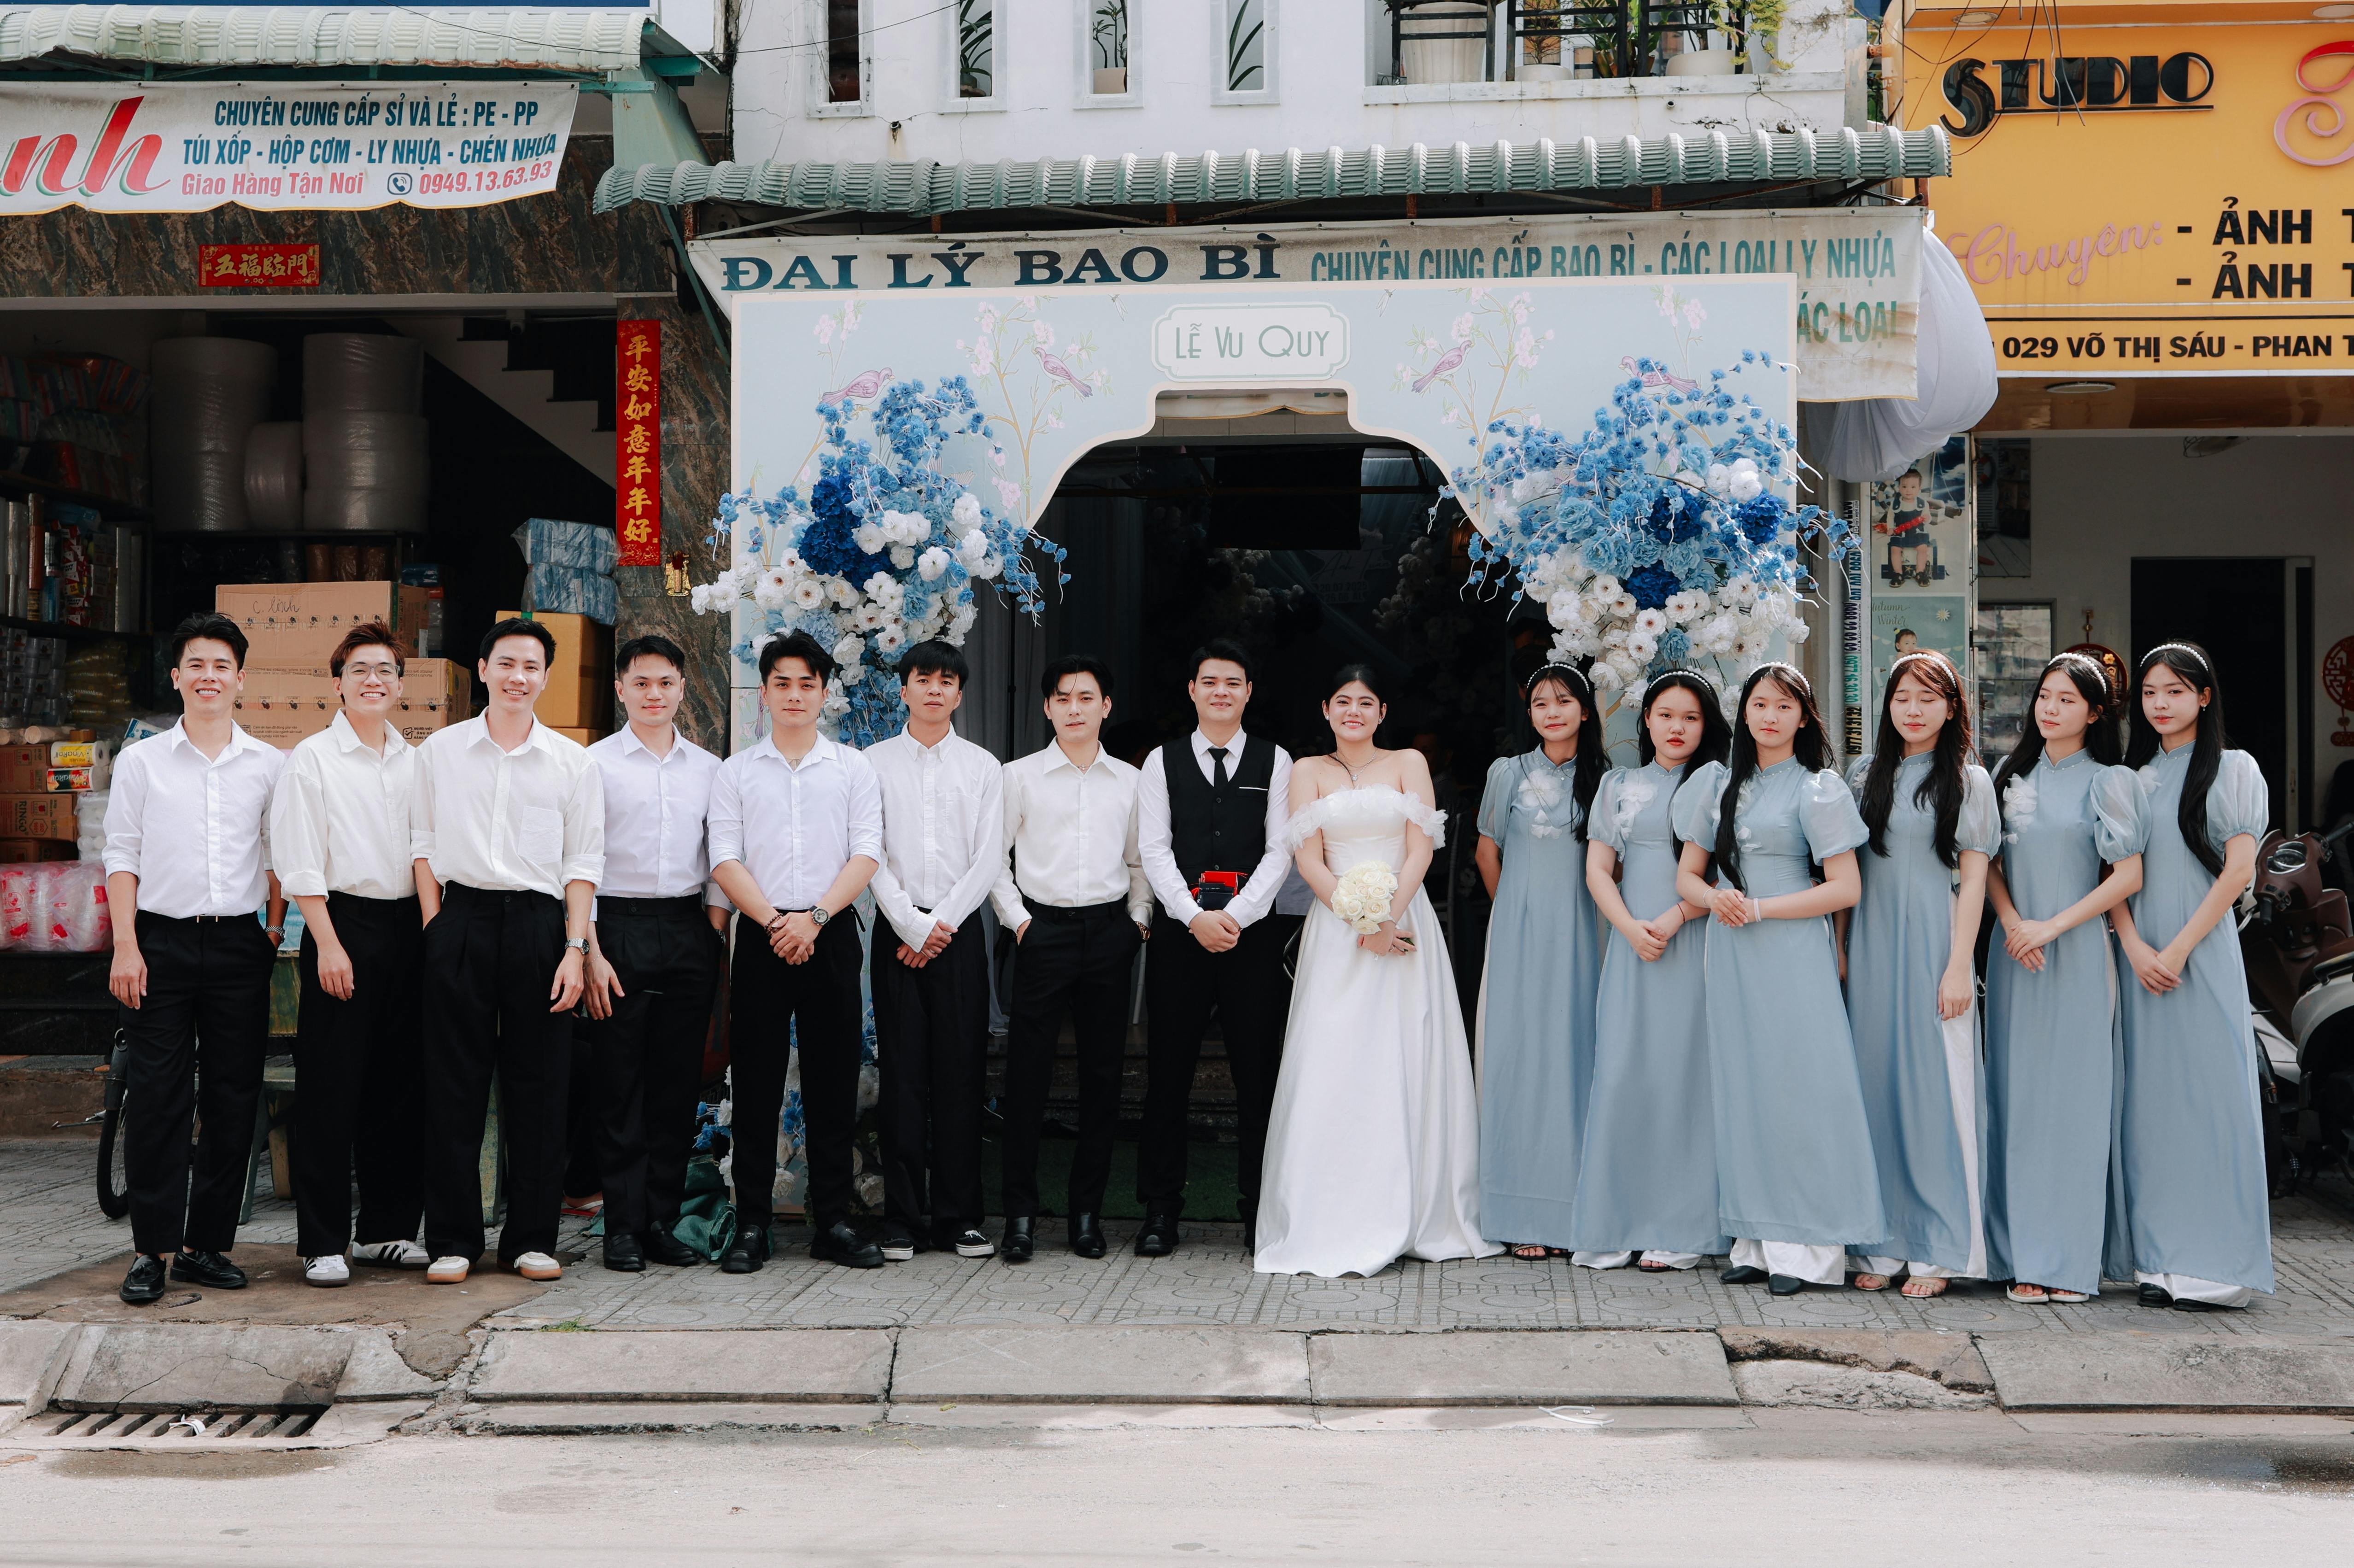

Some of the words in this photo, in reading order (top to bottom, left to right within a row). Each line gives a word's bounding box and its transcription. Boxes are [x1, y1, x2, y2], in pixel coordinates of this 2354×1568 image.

[215, 96, 286, 127] CHUYÊN
[290, 102, 339, 127] CUNG
[344, 92, 381, 126] CẤP
[386, 93, 406, 127] SỈ
[410, 96, 431, 127] VÀ
[437, 93, 458, 127] LẺ
[474, 101, 498, 127] PE
[514, 101, 539, 127] PP
[1938, 52, 2214, 138] STUDIO
[183, 134, 211, 165] TÚI
[216, 131, 252, 165] XỐP
[269, 137, 305, 170] HỘP
[310, 137, 351, 164] CƠM
[367, 140, 388, 164] LY
[392, 138, 441, 171] NHỰA
[460, 135, 508, 165] CHÉN
[512, 134, 557, 163] NHỰA
[182, 173, 225, 196] Giao
[233, 172, 282, 198] Hàng
[289, 172, 323, 199] Tận
[329, 171, 363, 195] Nơi
[420, 161, 552, 195] 0949.13.63.93
[2213, 197, 2312, 246] ẢNH
[887, 242, 984, 288] LÝ
[1014, 246, 1169, 285] BAO
[1199, 233, 1281, 280] BÌ
[1311, 239, 1410, 281] CHUYÊN
[1418, 247, 1484, 280] CUNG
[1493, 229, 1542, 278] CẤP
[1551, 244, 1601, 277] BAO
[1610, 232, 1635, 276] BÌ
[1661, 230, 1710, 275] CÁC
[1827, 229, 1896, 287] NHỰA
[2212, 251, 2312, 299] ẢNH
[1214, 326, 1243, 358] VU
[1258, 325, 1329, 358] QUY
[1839, 300, 1897, 349] LOẠI
[2003, 337, 2059, 358] 029
[2067, 333, 2106, 358] VÕ
[2114, 337, 2161, 363] THỊ
[2170, 332, 2225, 358] SÁU
[2253, 335, 2332, 357] PHAN
[624, 334, 652, 544] 平安如意年年好
[1878, 613, 1909, 627] Winter
[1844, 655, 1858, 673] 0977
[1844, 683, 1858, 692] 30
[1844, 694, 1858, 703] 30
[1846, 737, 1862, 755] 0977
[18, 800, 27, 832] RINGO
